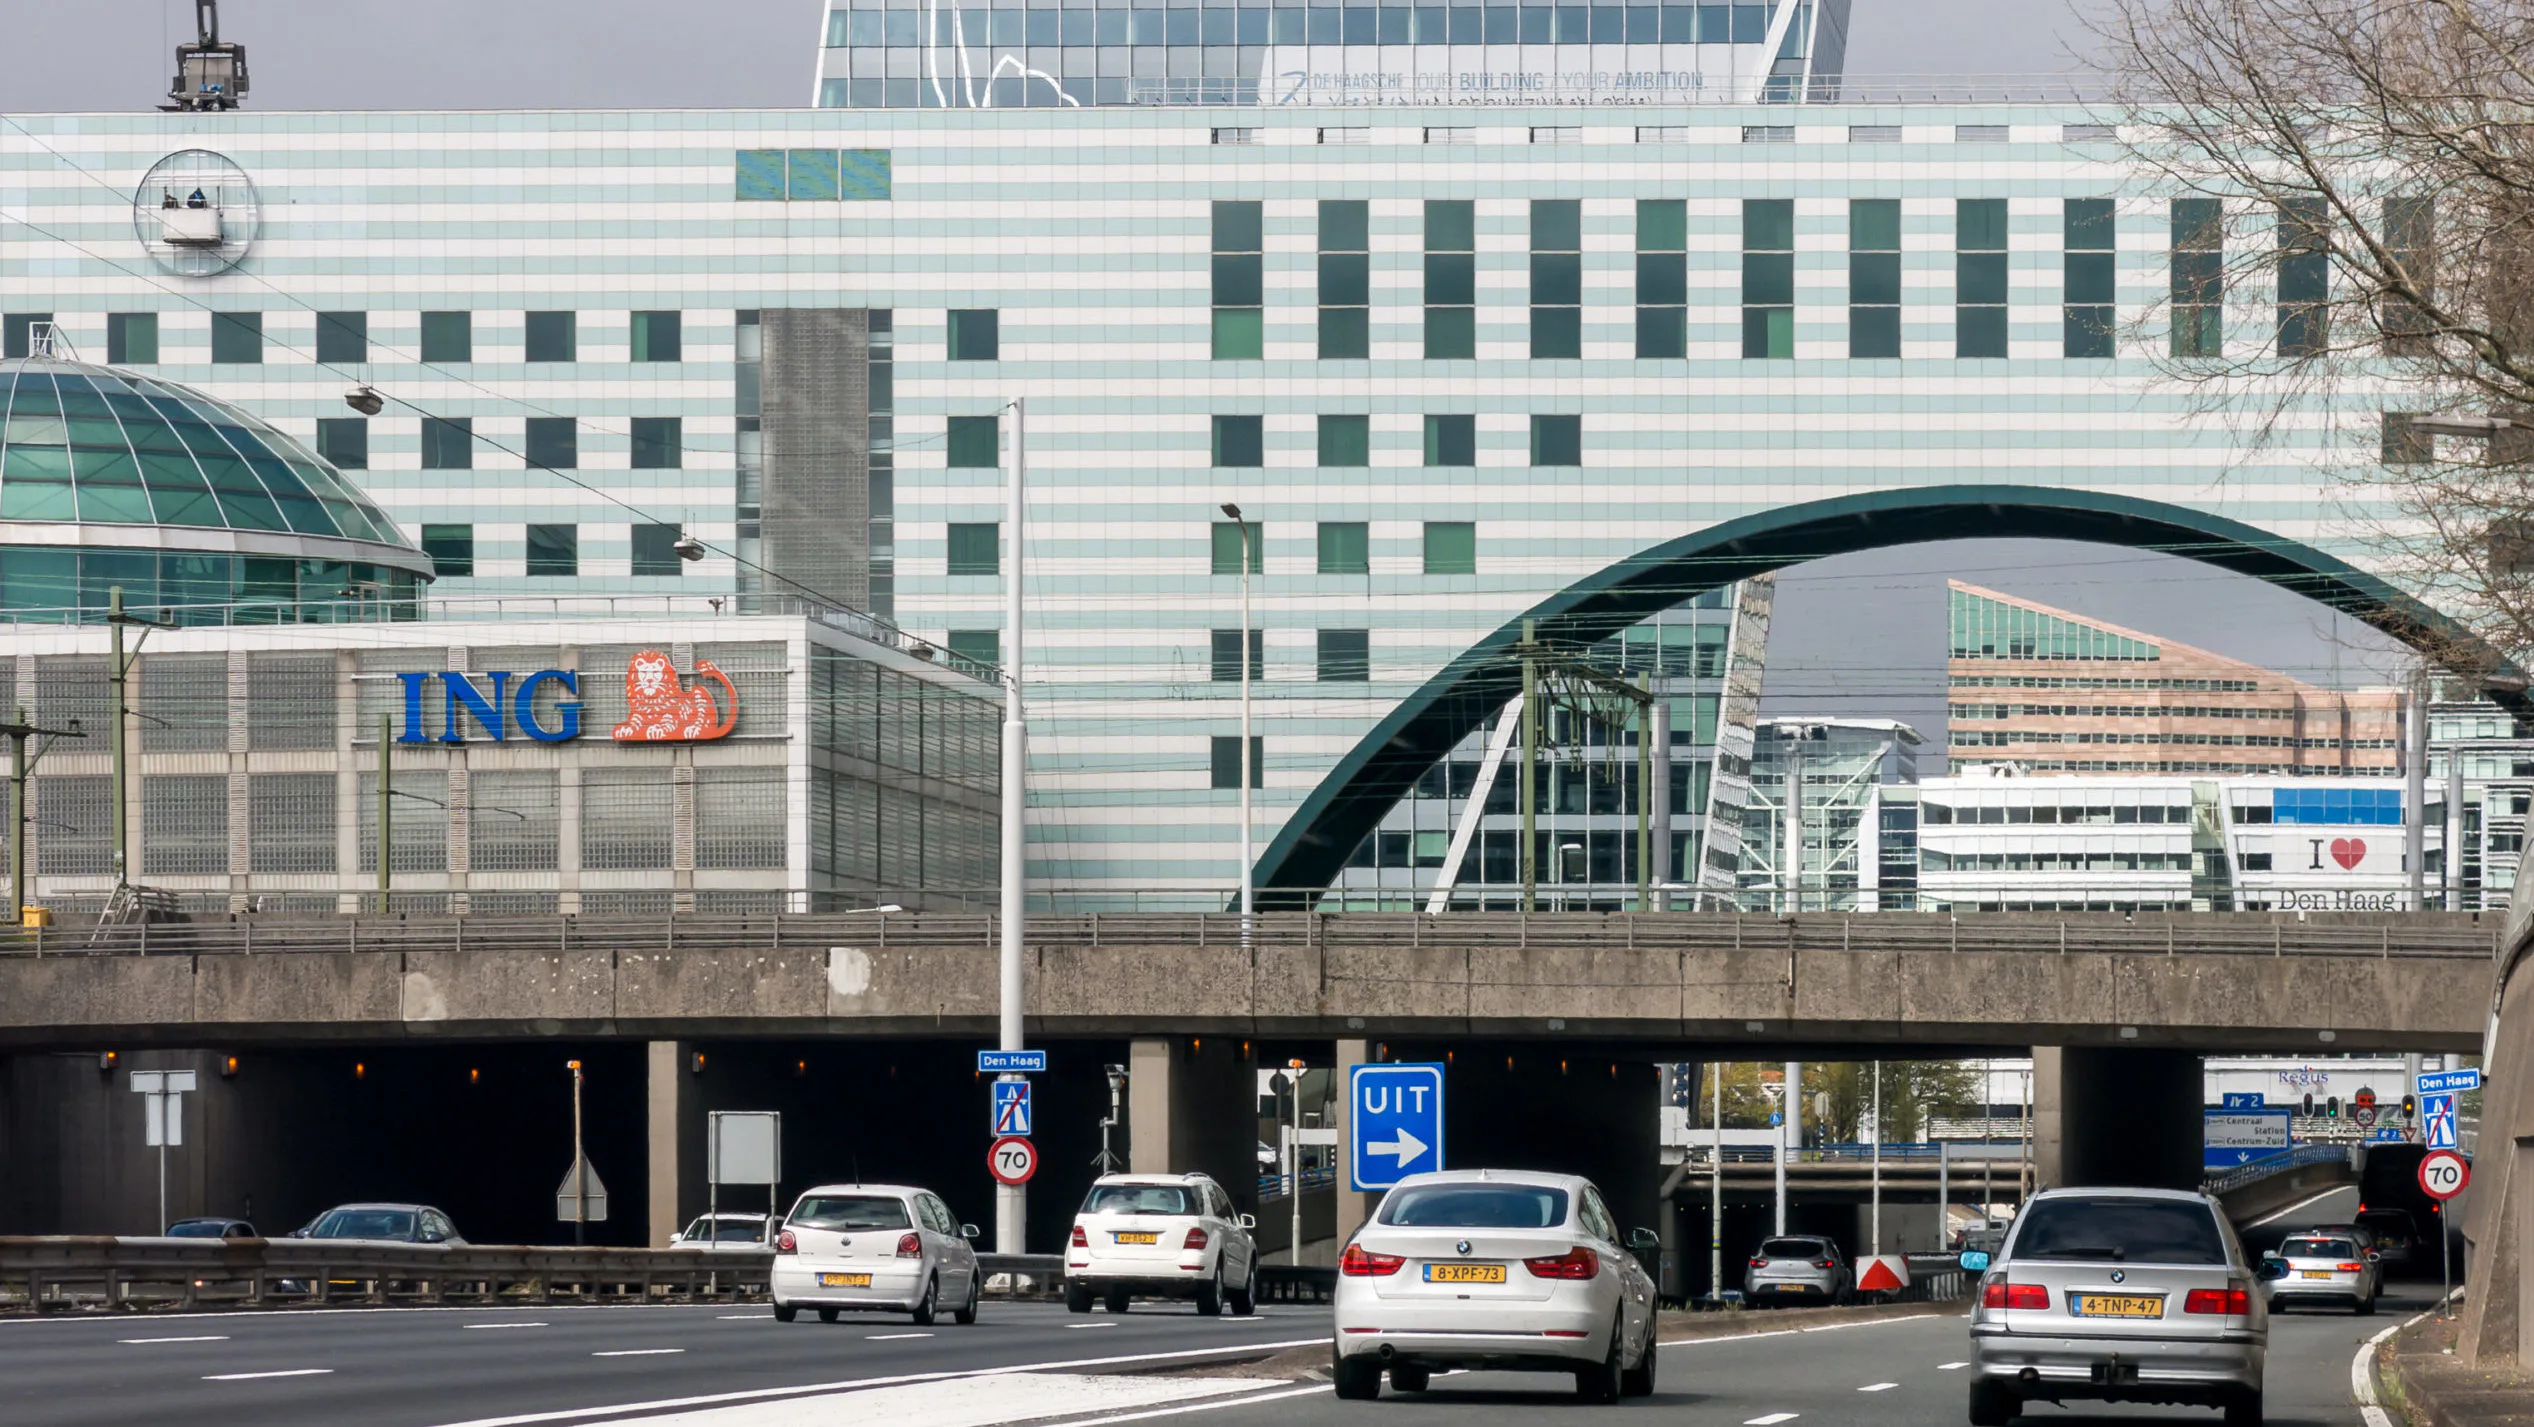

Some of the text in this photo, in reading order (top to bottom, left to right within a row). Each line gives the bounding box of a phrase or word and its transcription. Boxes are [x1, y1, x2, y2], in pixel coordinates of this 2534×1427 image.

[1460, 72, 1544, 91] BUILDING
[1562, 72, 1609, 91] YOUR
[396, 668, 585, 743] ING
[2308, 838, 2325, 870] I
[2278, 889, 2396, 912] Den Haag
[983, 1056, 1041, 1069] Den Haag
[2278, 1071, 2329, 1087] Regus
[2421, 1075, 2475, 1089] Den Haag
[1364, 1086, 1430, 1114] UIT
[2250, 1095, 2259, 1108] 2
[2226, 1117, 2263, 1125] Centraal
[2358, 1112, 2373, 1121] 50
[2254, 1127, 2286, 1136] Station
[2226, 1137, 2286, 1146] Centrum-Zuid
[998, 1151, 1028, 1169] 70
[2428, 1166, 2458, 1185] 70
[1437, 1267, 1499, 1281] 8-XPF-73
[2086, 1298, 2157, 1314] 4-TNP-47
